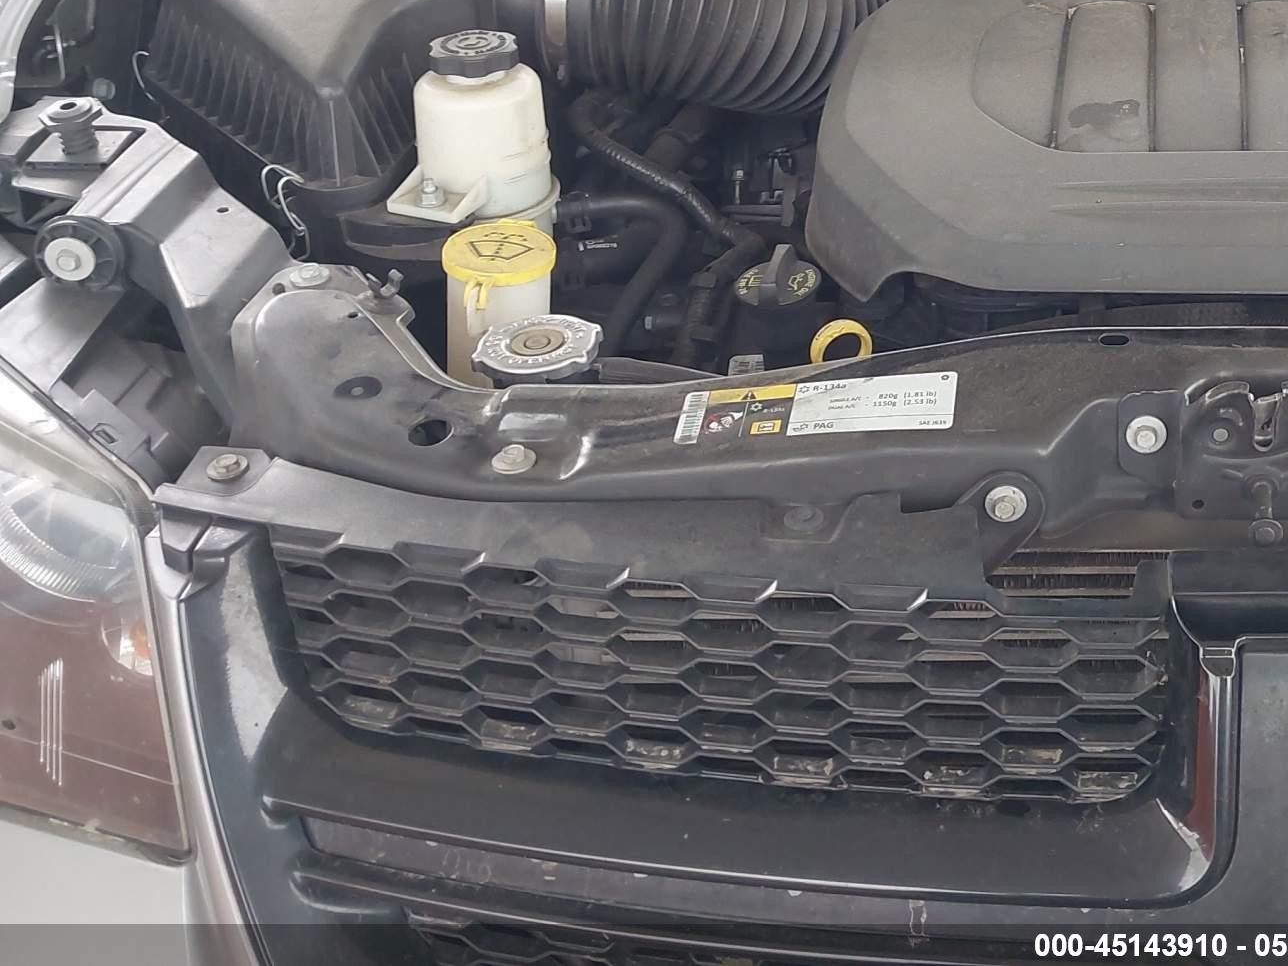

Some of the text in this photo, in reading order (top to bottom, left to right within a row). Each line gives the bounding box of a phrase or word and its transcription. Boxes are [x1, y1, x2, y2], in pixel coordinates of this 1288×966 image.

[813, 383, 847, 392] R-134a
[878, 393, 898, 401] 820g
[873, 400, 897, 408] 1150g
[813, 421, 834, 430] PAG
